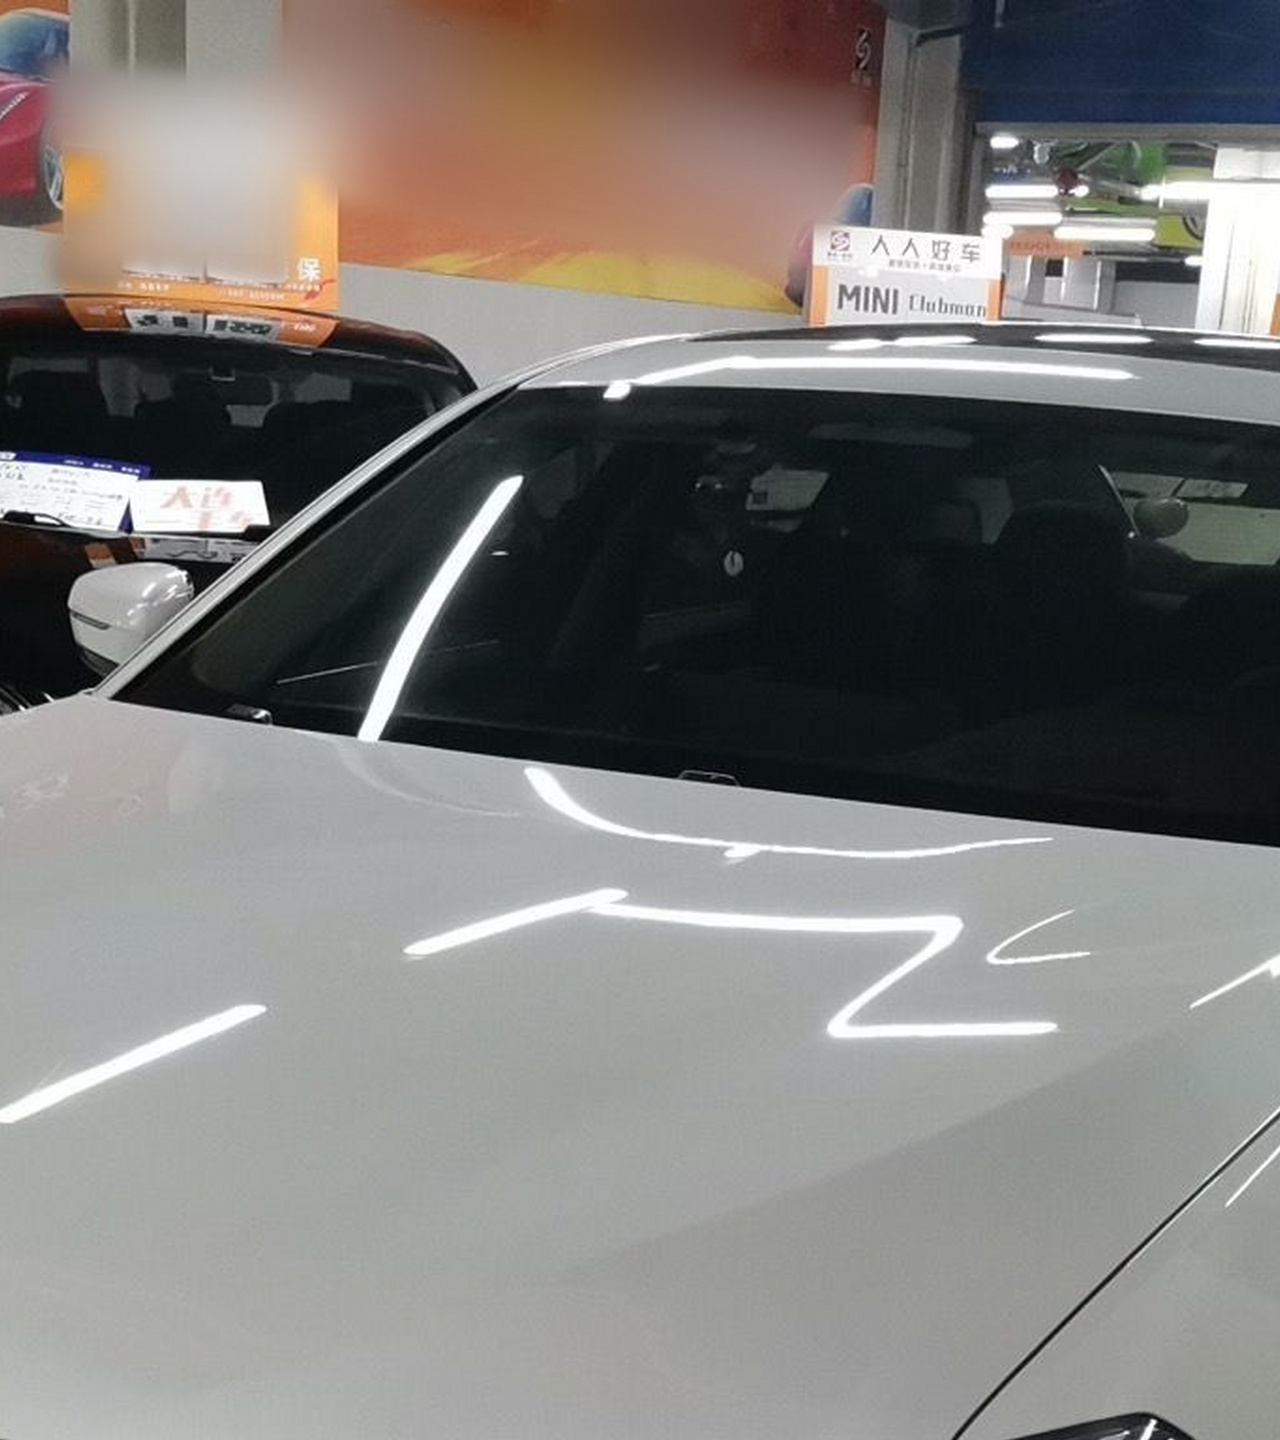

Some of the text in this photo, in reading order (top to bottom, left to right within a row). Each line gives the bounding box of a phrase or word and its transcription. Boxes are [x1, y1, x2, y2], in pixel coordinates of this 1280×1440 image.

[870, 234, 982, 263] 人人好车
[836, 283, 900, 315] MINI
